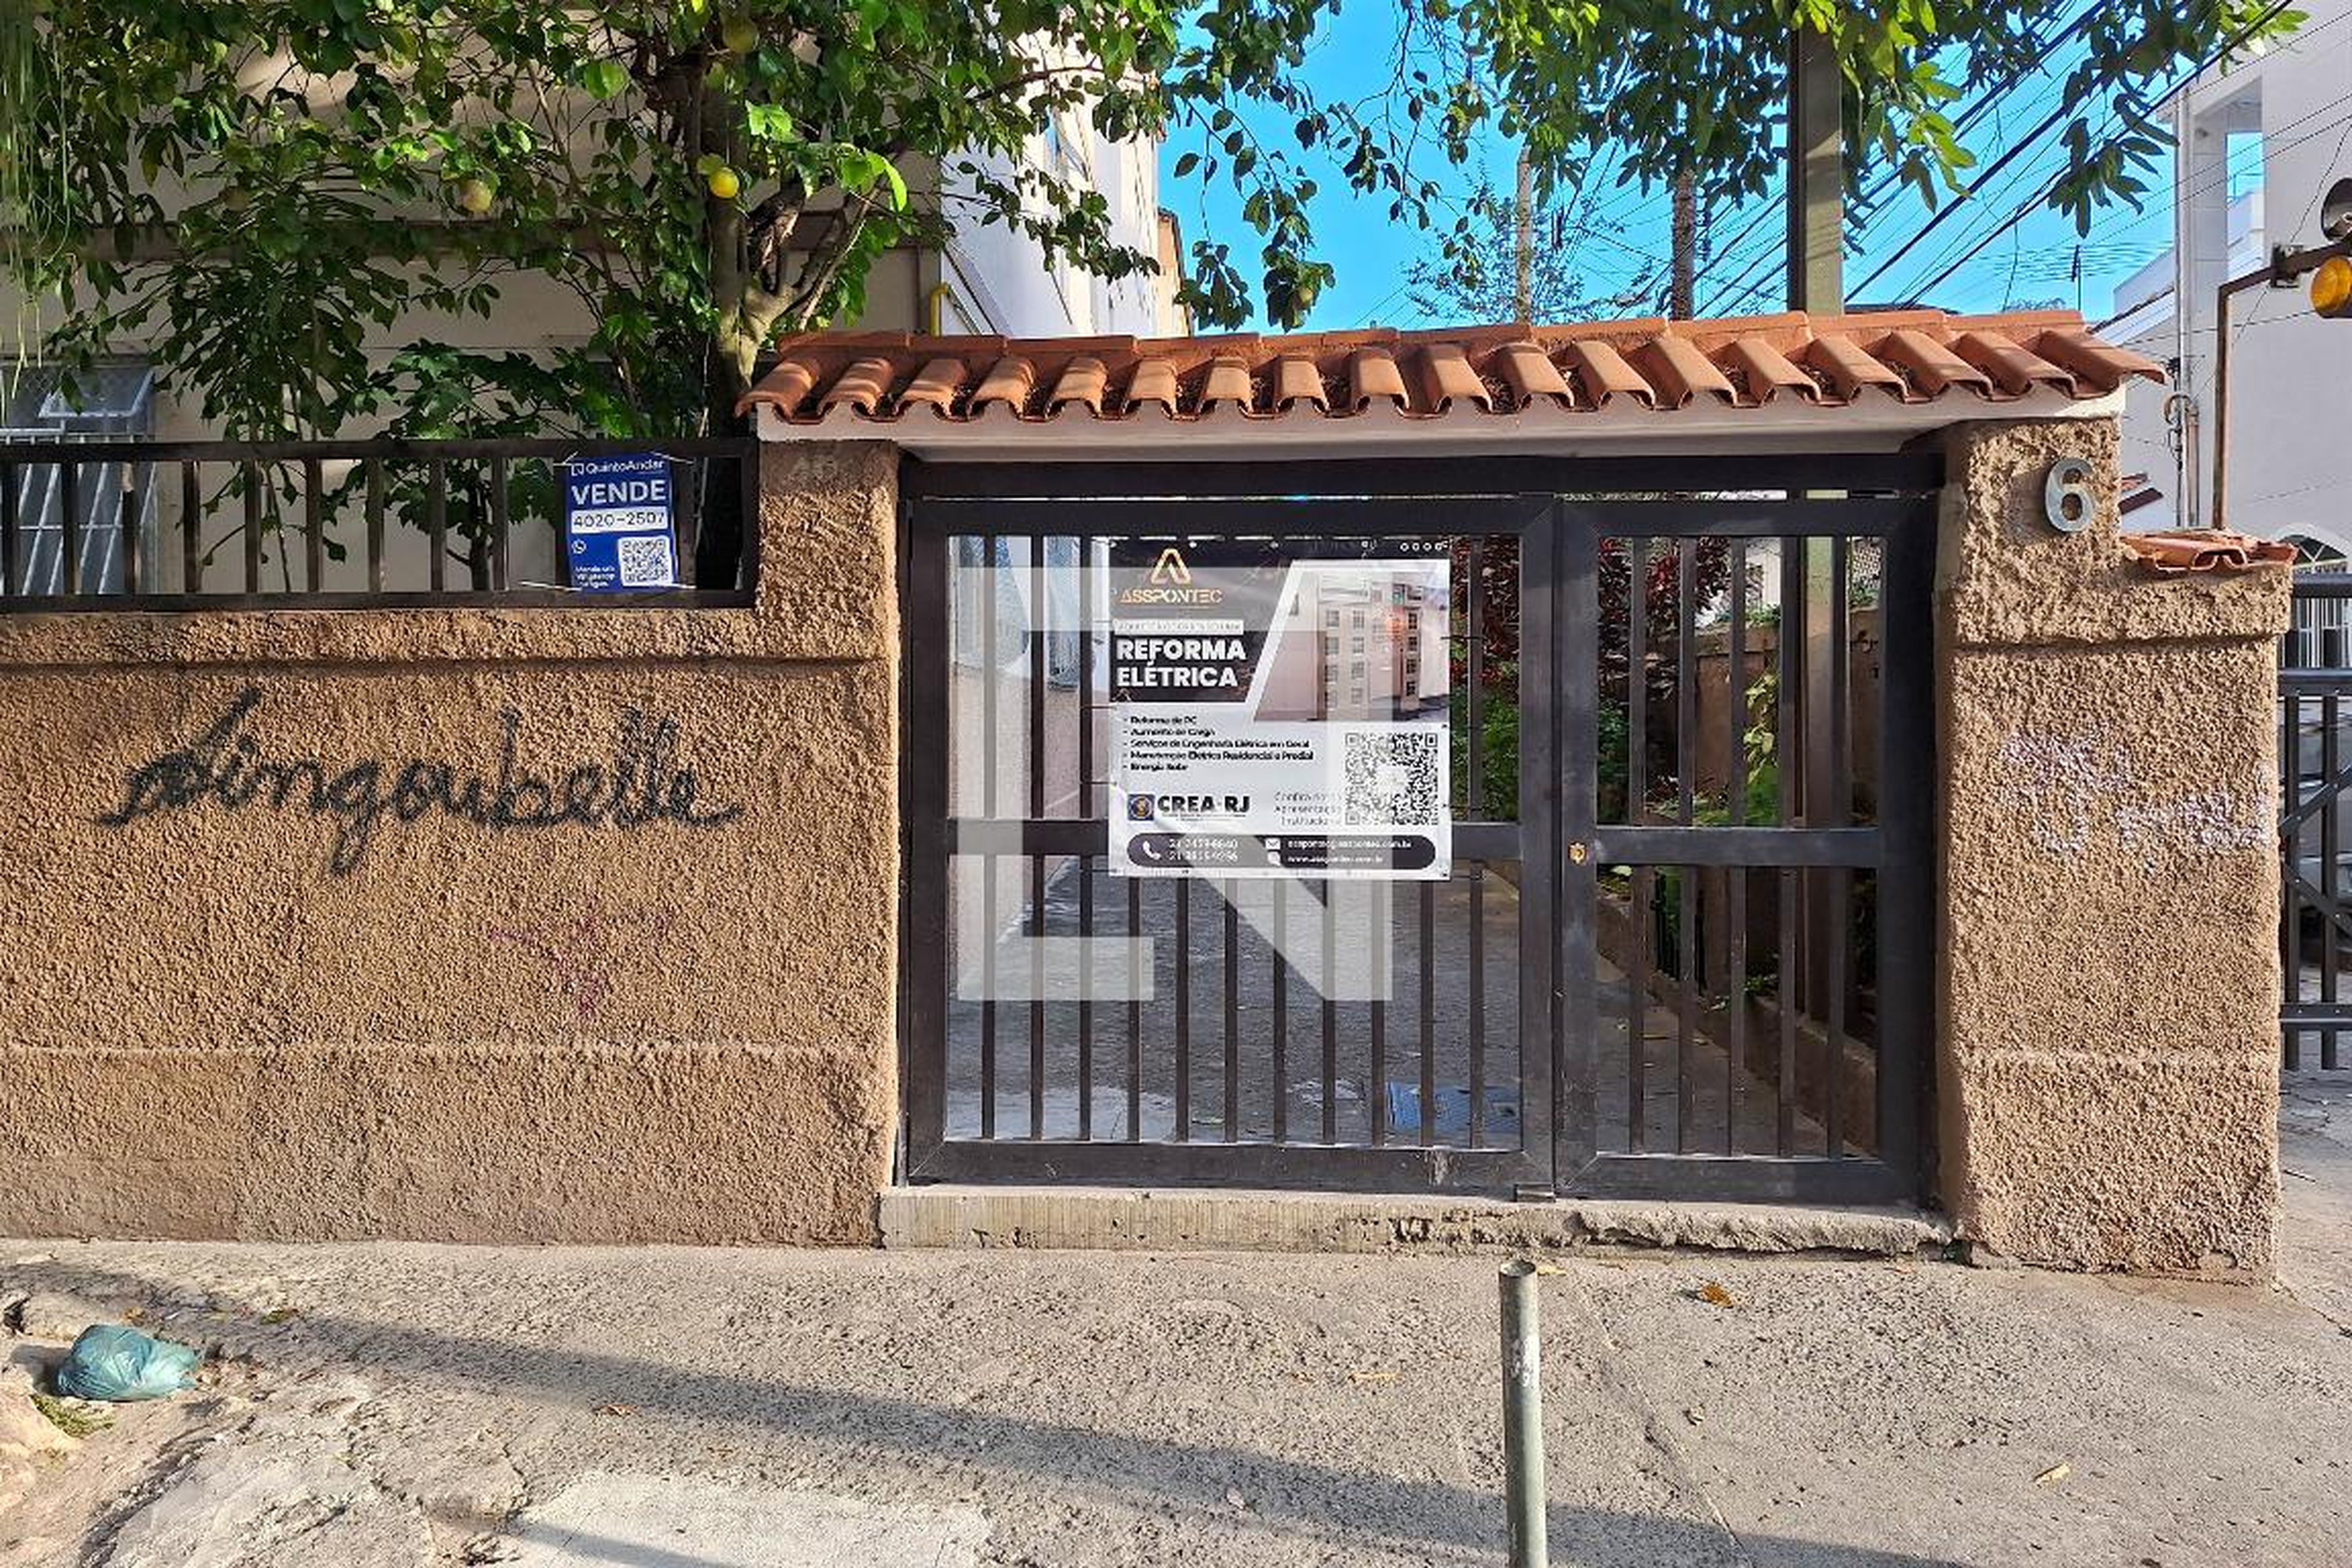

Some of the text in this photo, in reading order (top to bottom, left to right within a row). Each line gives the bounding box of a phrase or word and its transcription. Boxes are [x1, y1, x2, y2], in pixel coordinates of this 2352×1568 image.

[586, 461, 665, 474] QuintoAndar
[571, 479, 666, 505] VENDE
[2045, 457, 2094, 533] 6
[573, 511, 665, 528] 4020-2507
[1120, 589, 1223, 603] ASSPONTEC
[1116, 638, 1247, 660] REFORMA
[1116, 660, 1238, 687] ELÉTRICA
